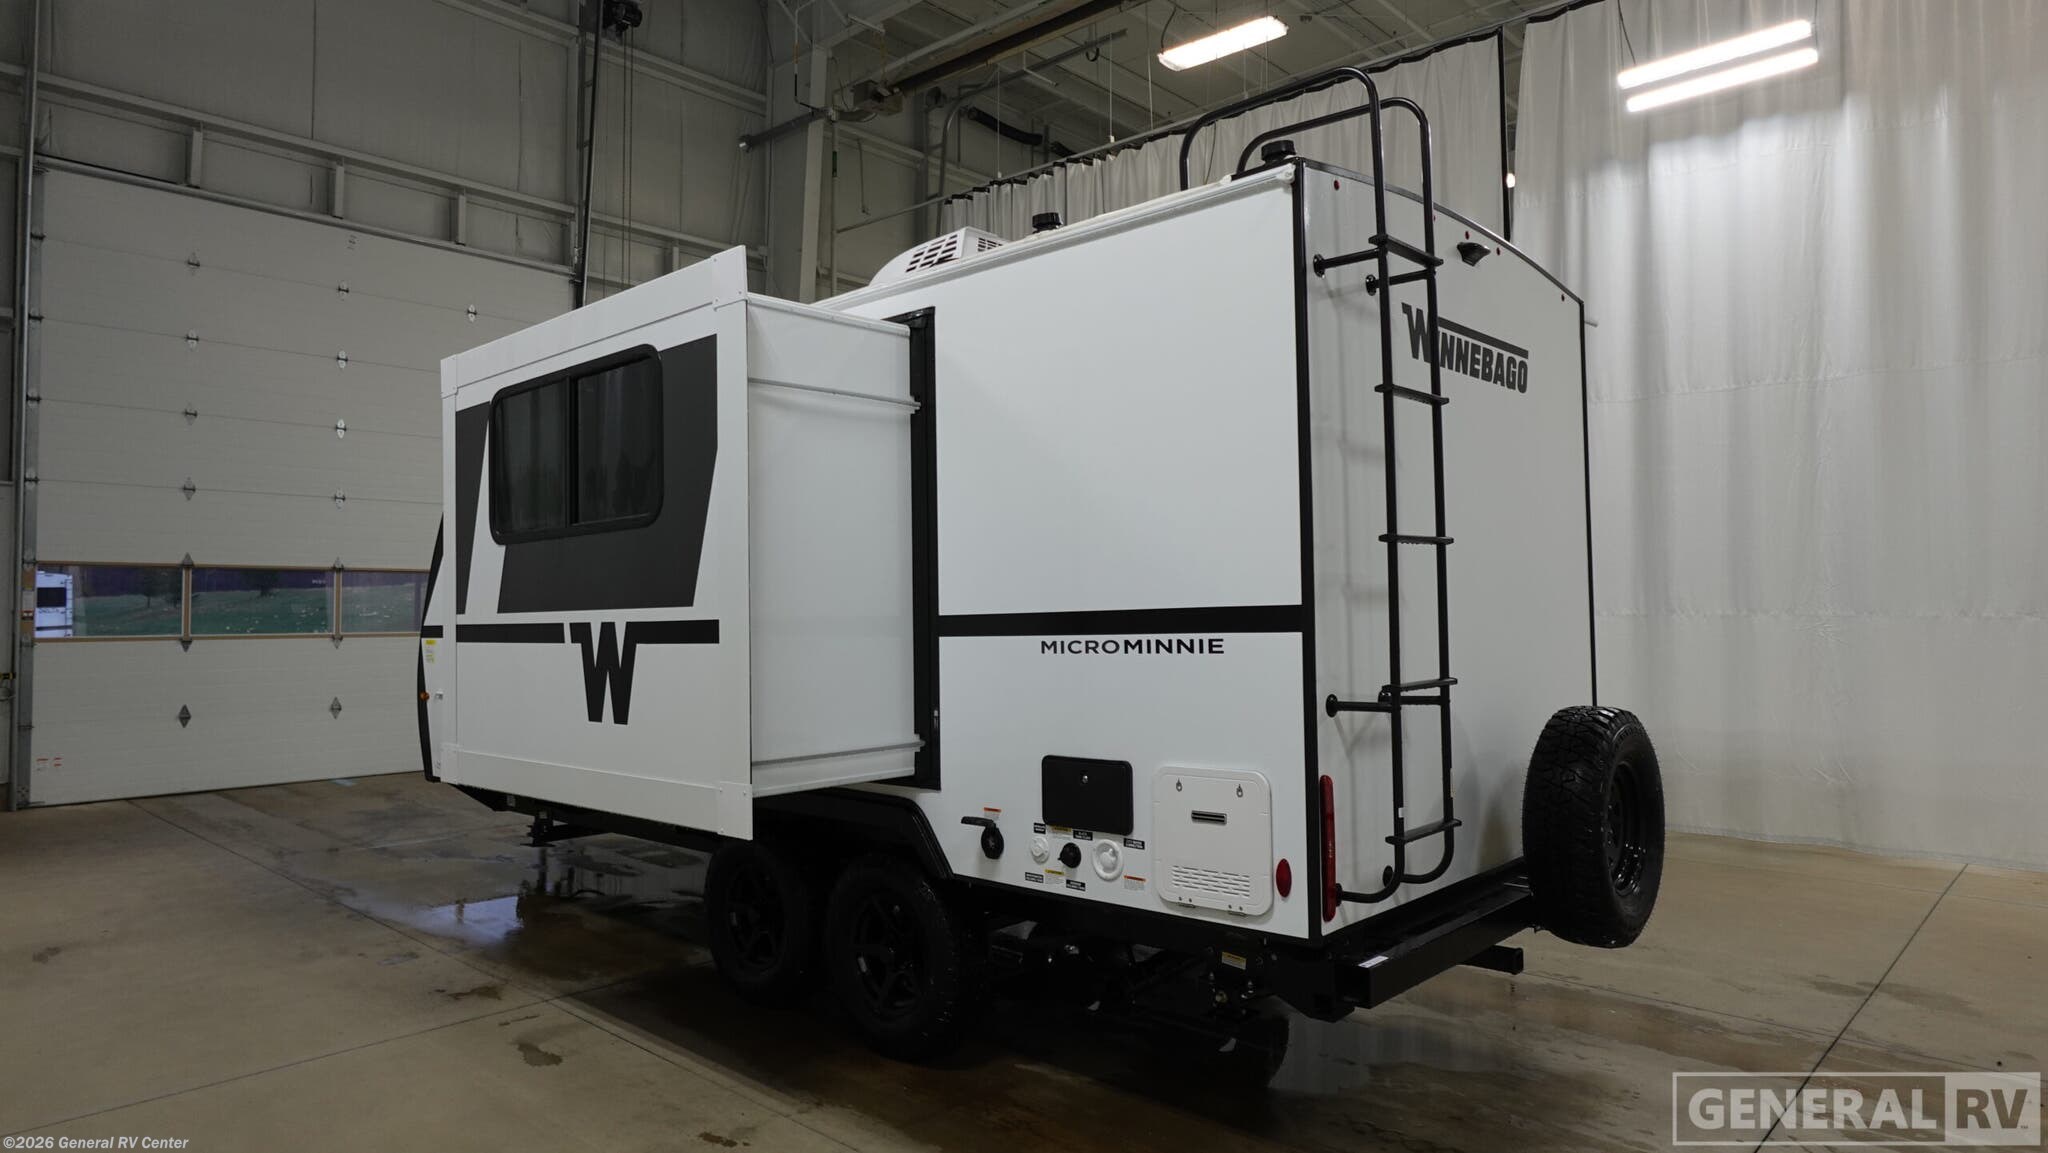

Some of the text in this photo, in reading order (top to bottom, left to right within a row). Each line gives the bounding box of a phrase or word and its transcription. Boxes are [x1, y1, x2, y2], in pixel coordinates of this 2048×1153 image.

[1401, 302, 1528, 393] WNNEBAGO
[569, 621, 637, 725] W
[1040, 638, 1225, 655] MICROMINNIE
